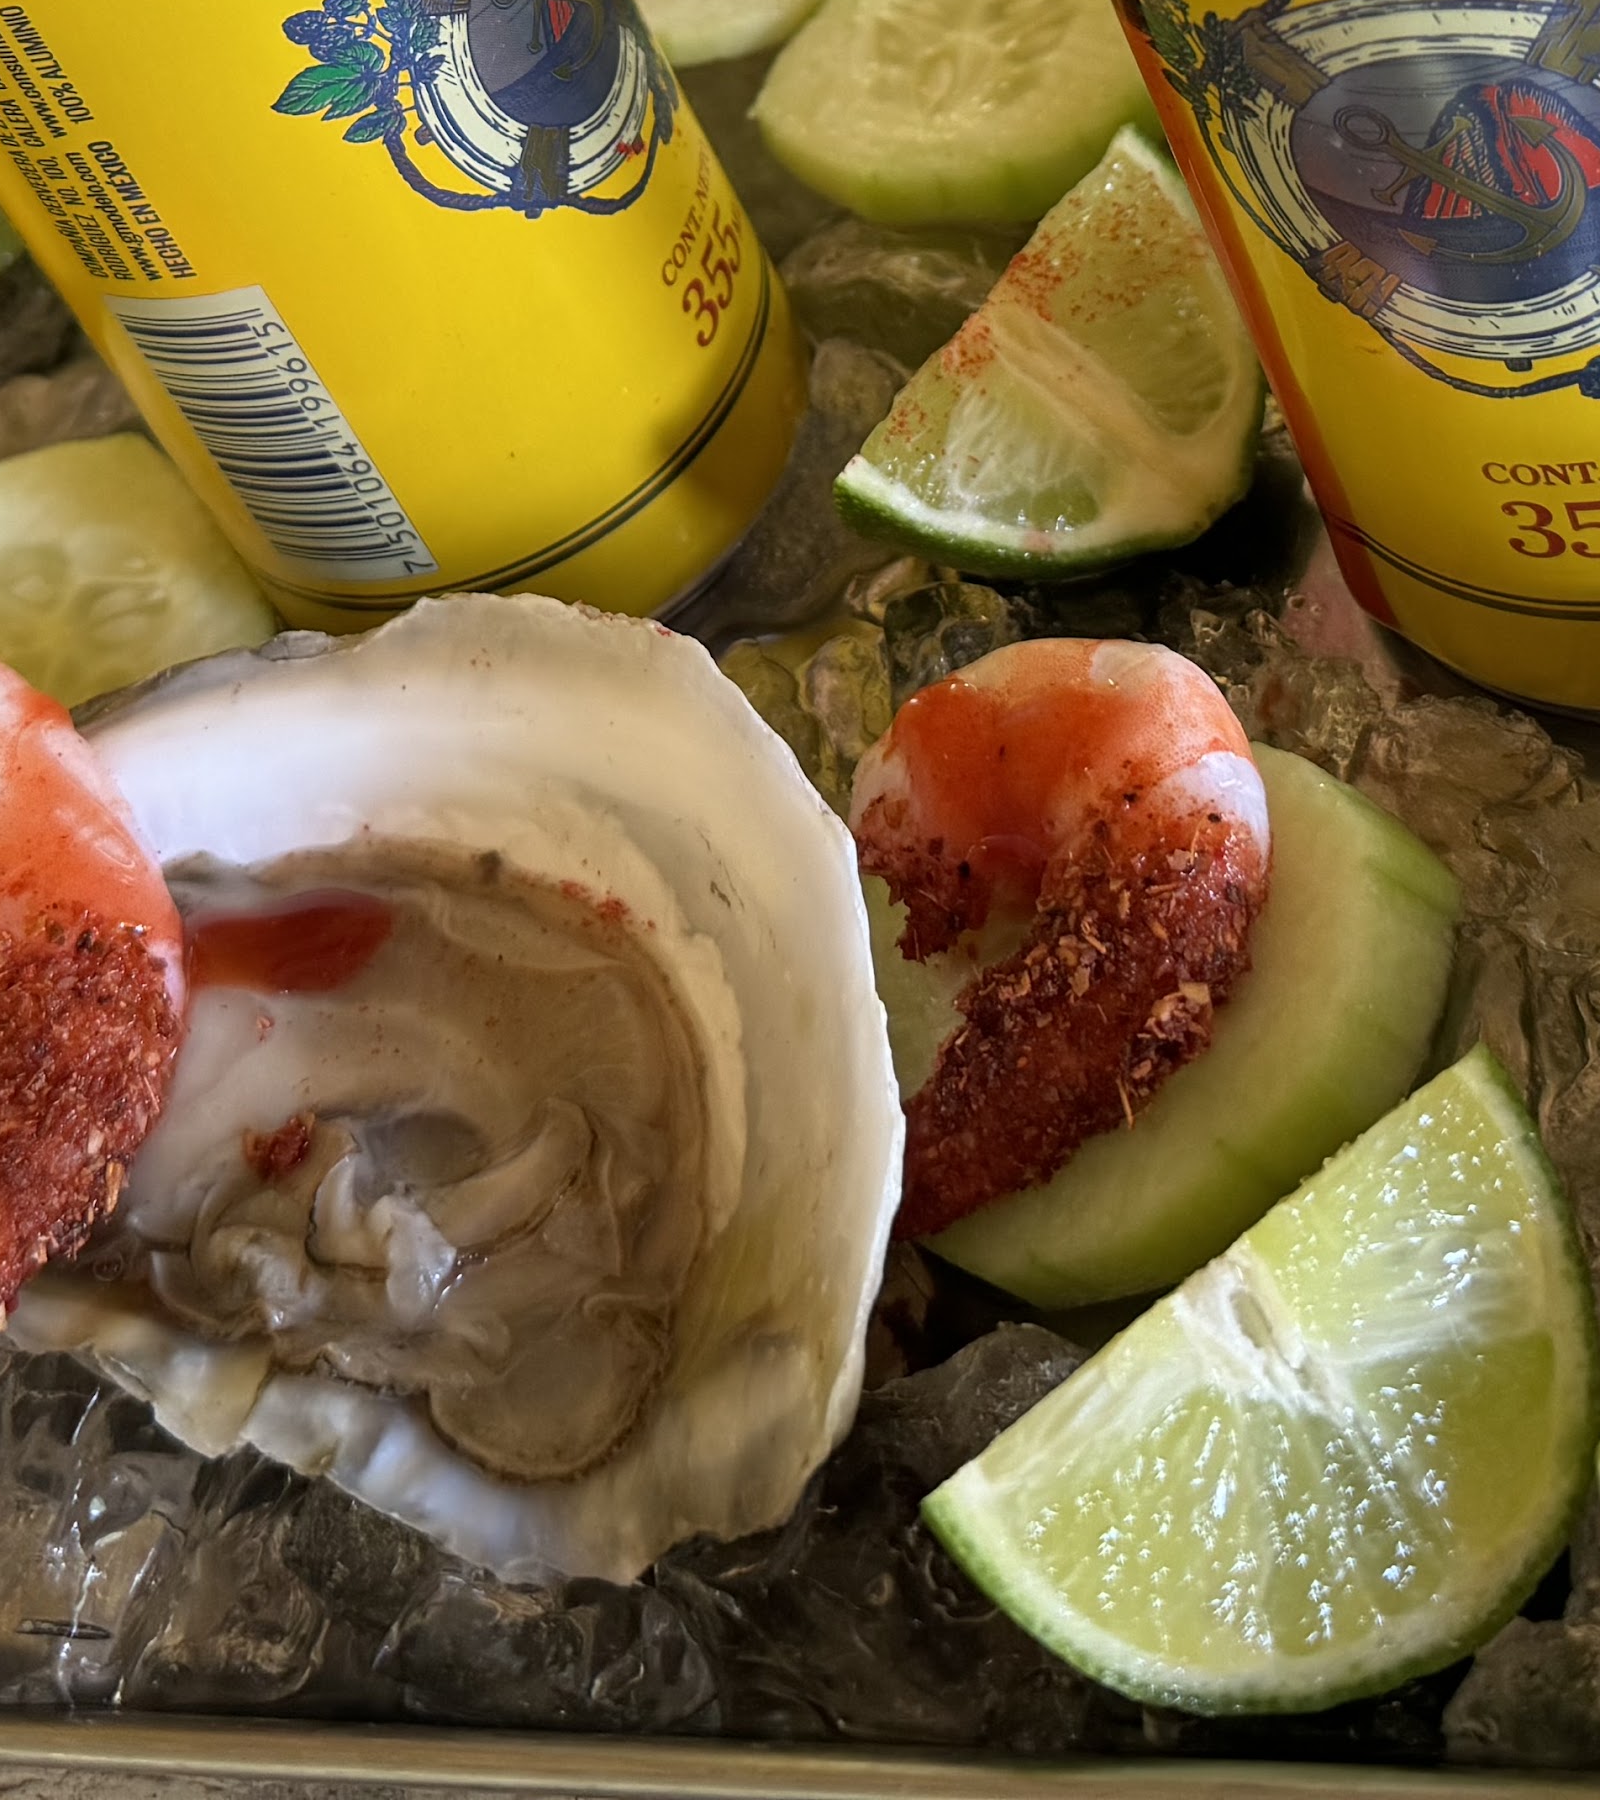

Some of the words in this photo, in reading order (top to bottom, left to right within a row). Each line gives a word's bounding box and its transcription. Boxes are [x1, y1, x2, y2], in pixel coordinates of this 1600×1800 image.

[45, 78, 95, 126] 100%
[6, 147, 68, 219] CERVECERA
[55, 184, 86, 209] NO.
[84, 136, 147, 201] MÉXICO
[62, 148, 163, 283] www.gmodelo.com
[126, 201, 162, 226] EN
[662, 204, 703, 286] CONT.
[52, 219, 110, 278] COMPAÑÍA
[71, 211, 136, 282] RODRÍGUEZ
[143, 224, 198, 281] HECHO
[682, 200, 743, 347] 355
